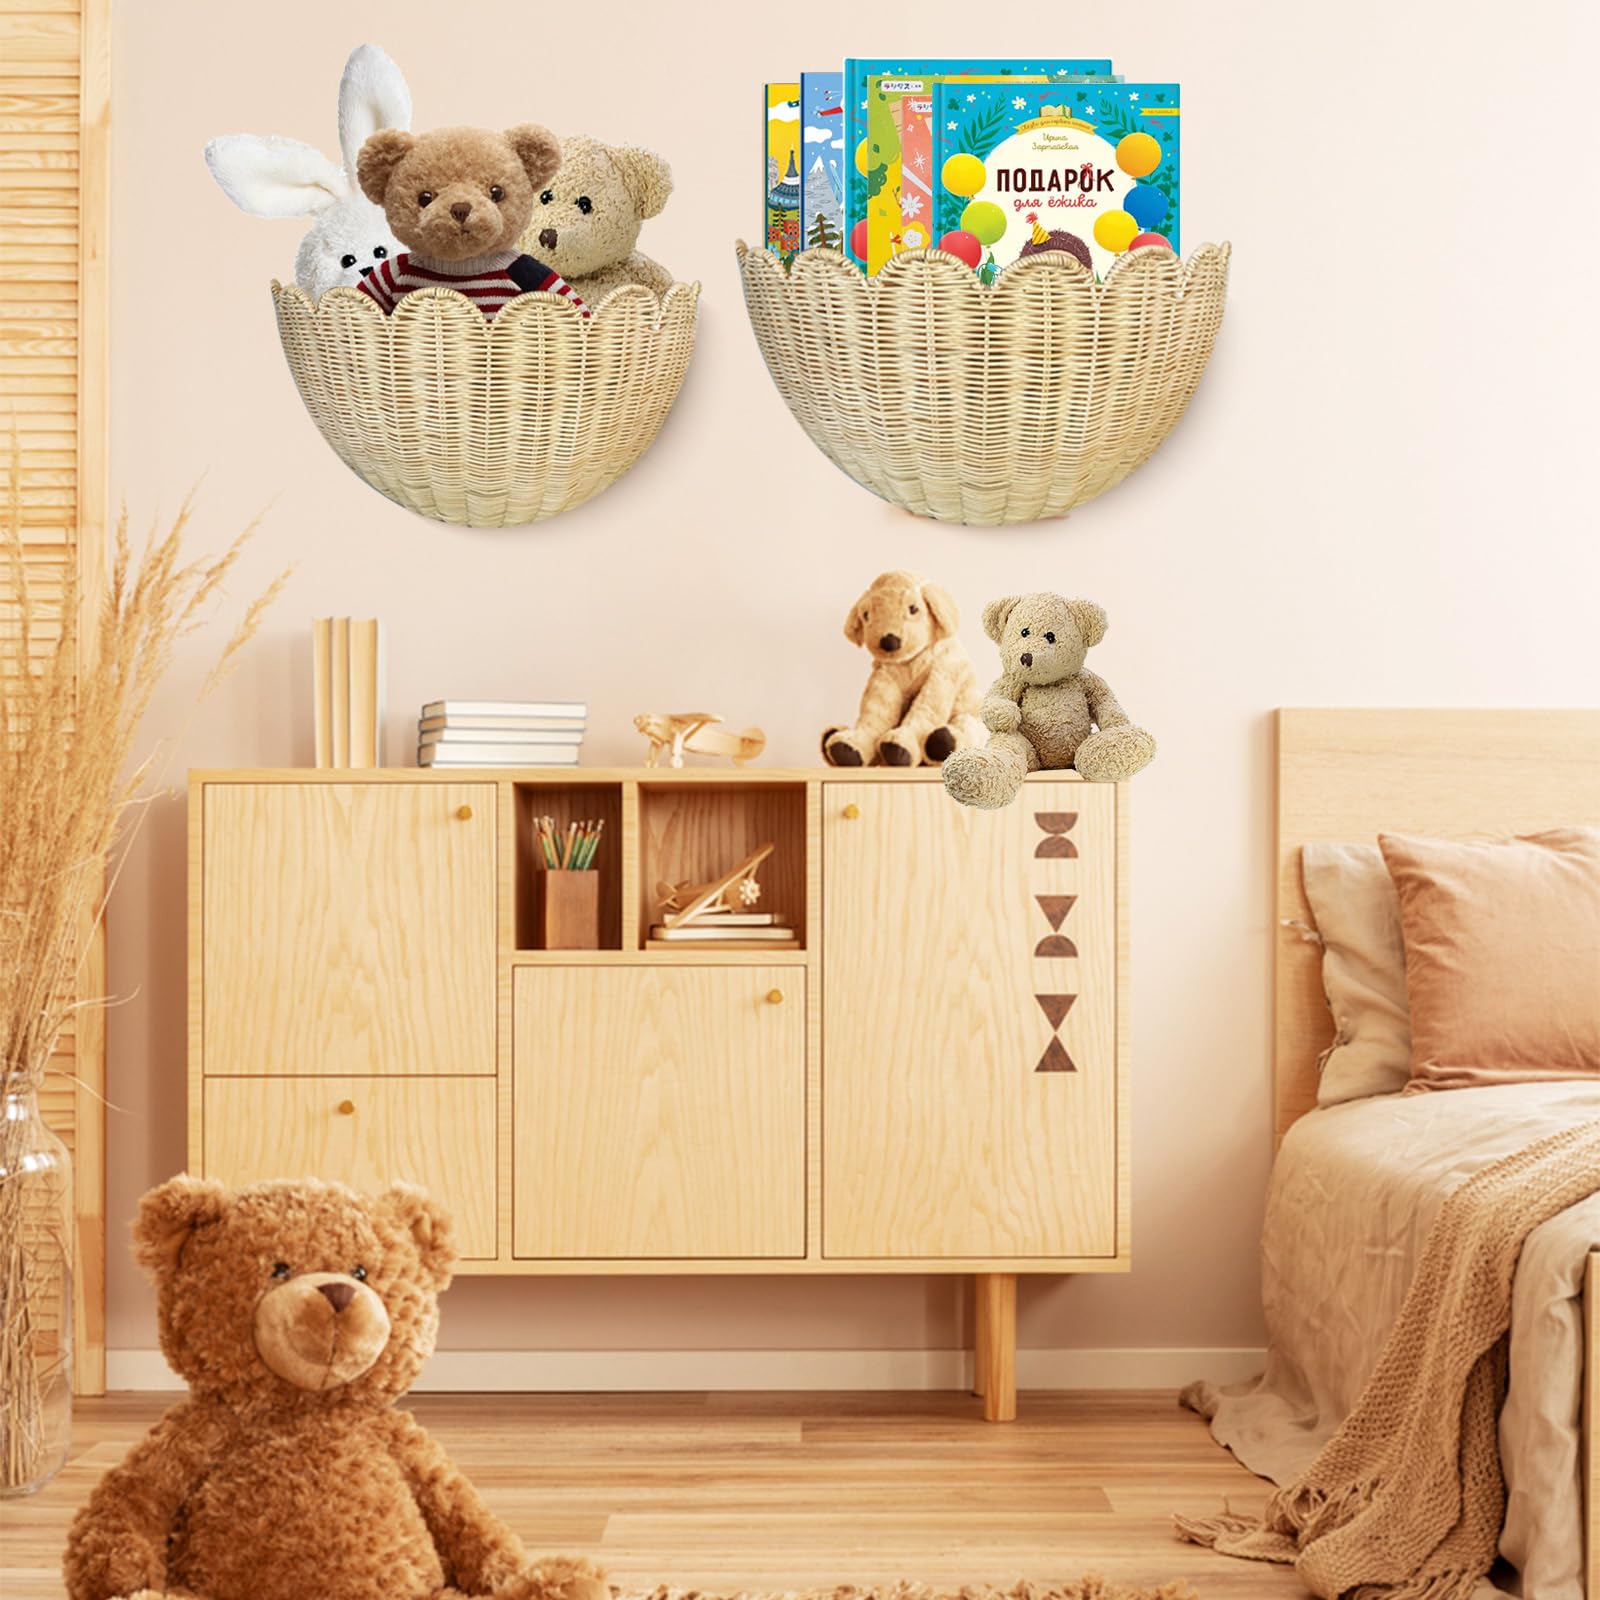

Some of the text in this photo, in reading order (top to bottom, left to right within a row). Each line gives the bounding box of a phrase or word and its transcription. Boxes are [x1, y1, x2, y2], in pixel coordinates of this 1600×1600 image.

[996, 167, 1116, 193] ПОДАРОК
[1013, 193, 1098, 212] для ёжика
